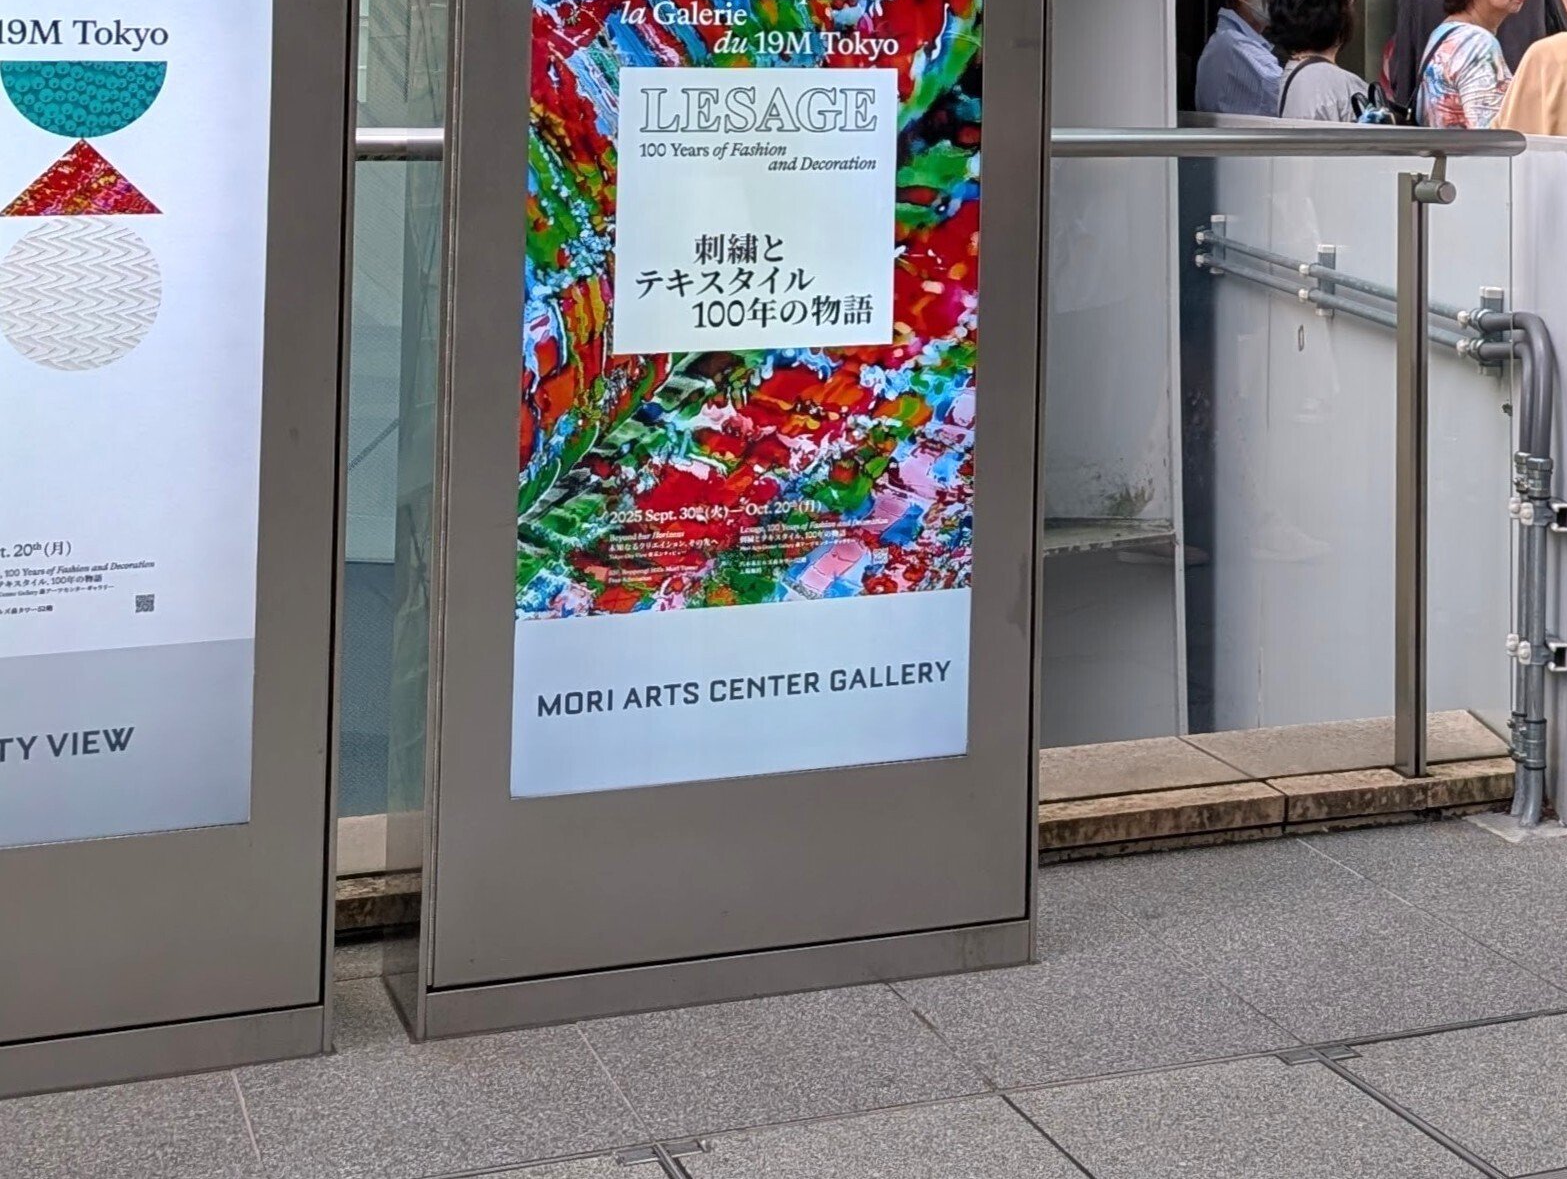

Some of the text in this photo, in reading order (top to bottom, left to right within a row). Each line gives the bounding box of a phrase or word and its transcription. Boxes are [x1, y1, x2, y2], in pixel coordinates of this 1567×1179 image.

[620, 0, 747, 26] la Galerie
[72, 20, 169, 52] Tokyo
[714, 30, 899, 60] du 19M Tokyo
[640, 86, 877, 134] LESAGE
[639, 141, 787, 160] 100 Years of Fashion
[768, 156, 876, 172] and Decoration
[694, 233, 784, 265] 刺繍と
[635, 267, 815, 299] テキスタイル
[692, 294, 873, 329] 100年の物語
[610, 510, 642, 524] 2025
[645, 509, 677, 523] Sept.
[22, 567, 45, 577] Years
[91, 563, 108, 572] and
[537, 660, 952, 717] MORI ARTS CENTER GALLERY
[47, 726, 135, 758] VIEW
